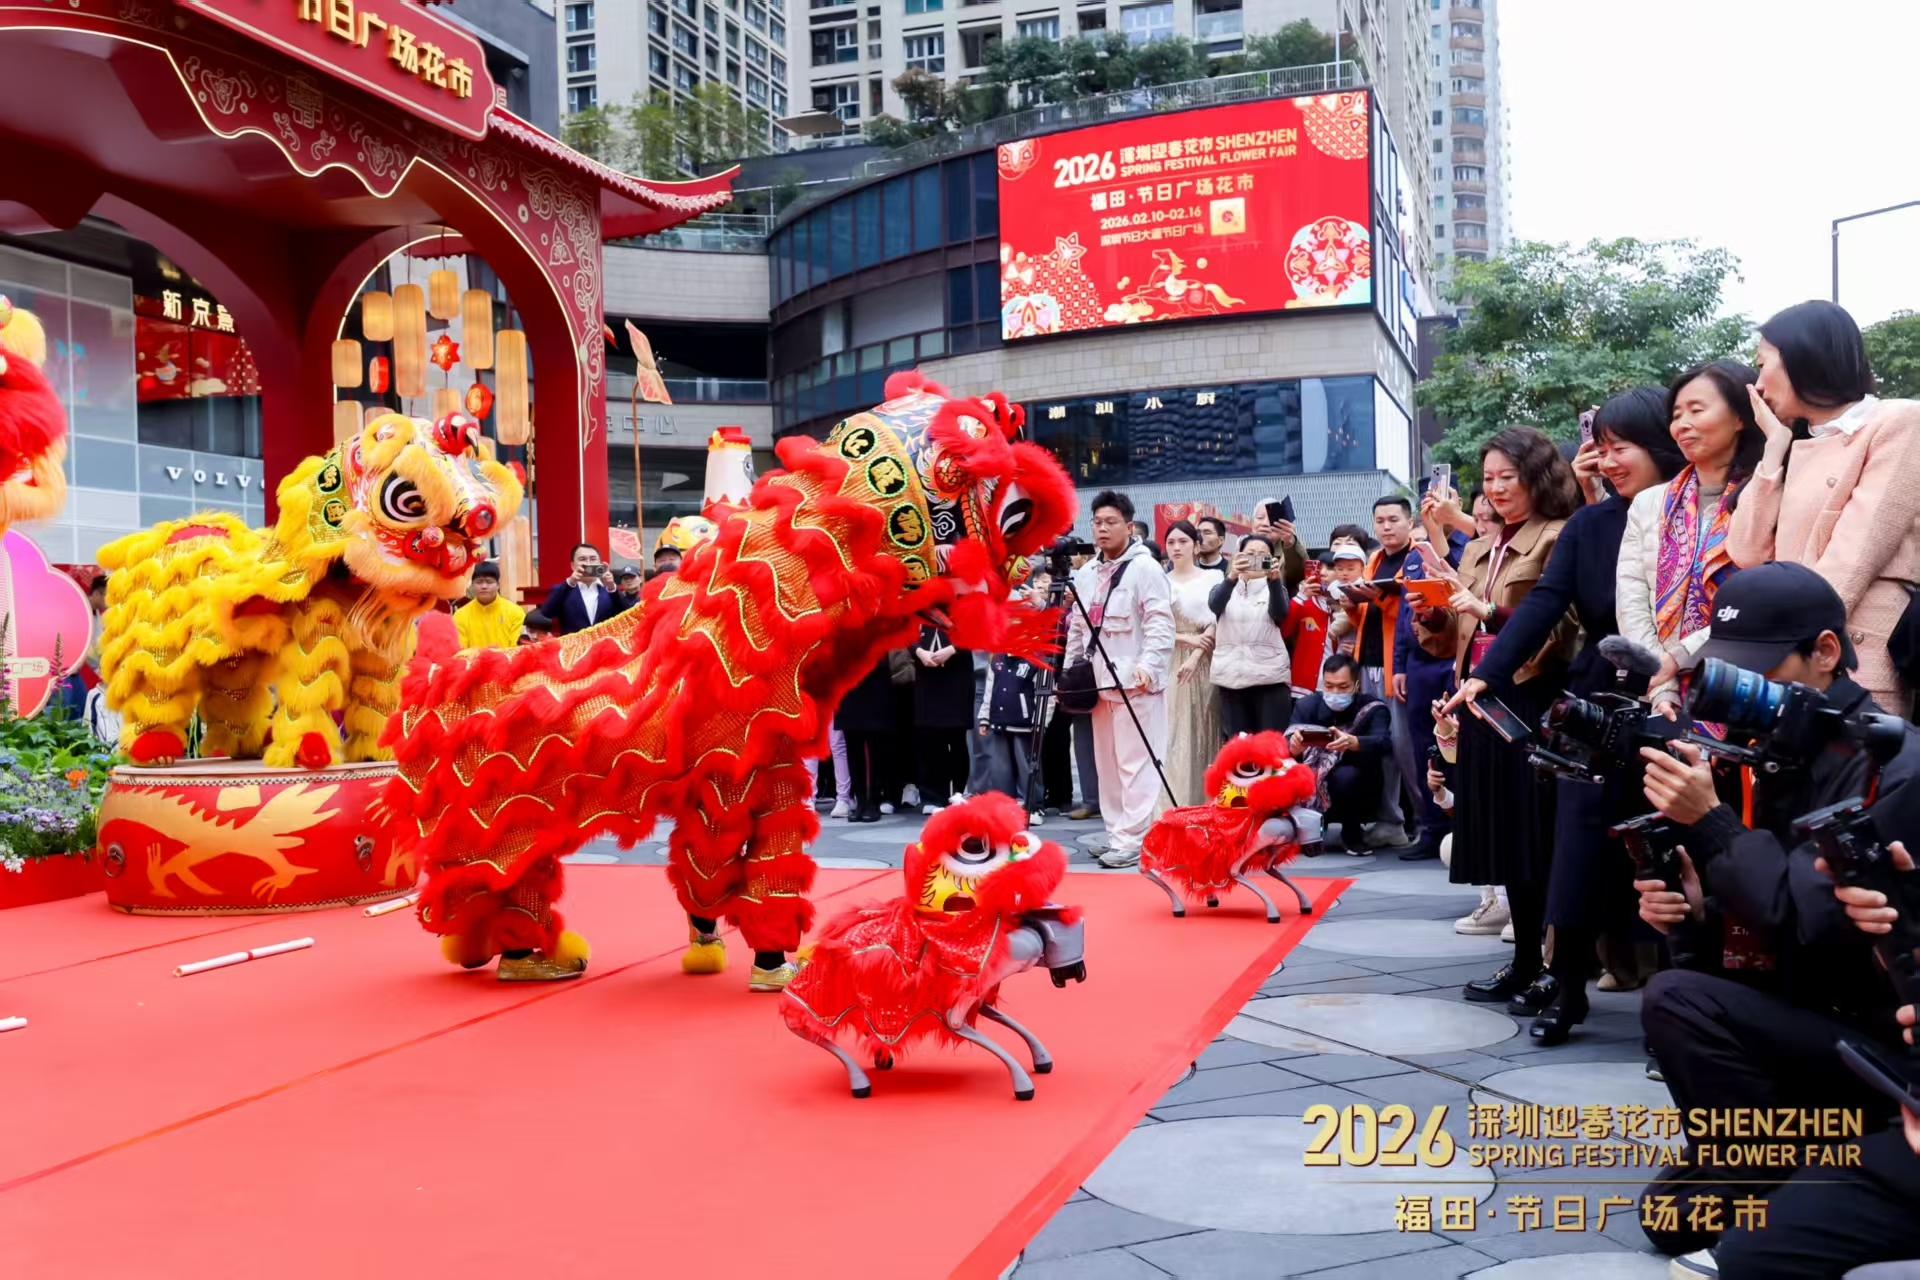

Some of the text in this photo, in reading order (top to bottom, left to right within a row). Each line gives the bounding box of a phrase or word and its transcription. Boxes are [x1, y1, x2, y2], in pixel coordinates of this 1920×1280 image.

[1054, 128, 1297, 188] 2026 深圳迎春花市 SHENZHEN
[1120, 144, 1297, 178] SPRING FESTIVAL FLOWER FAIR
[1100, 206, 1202, 230] 2026.02.10-02.16
[166, 465, 264, 488] VOLV
